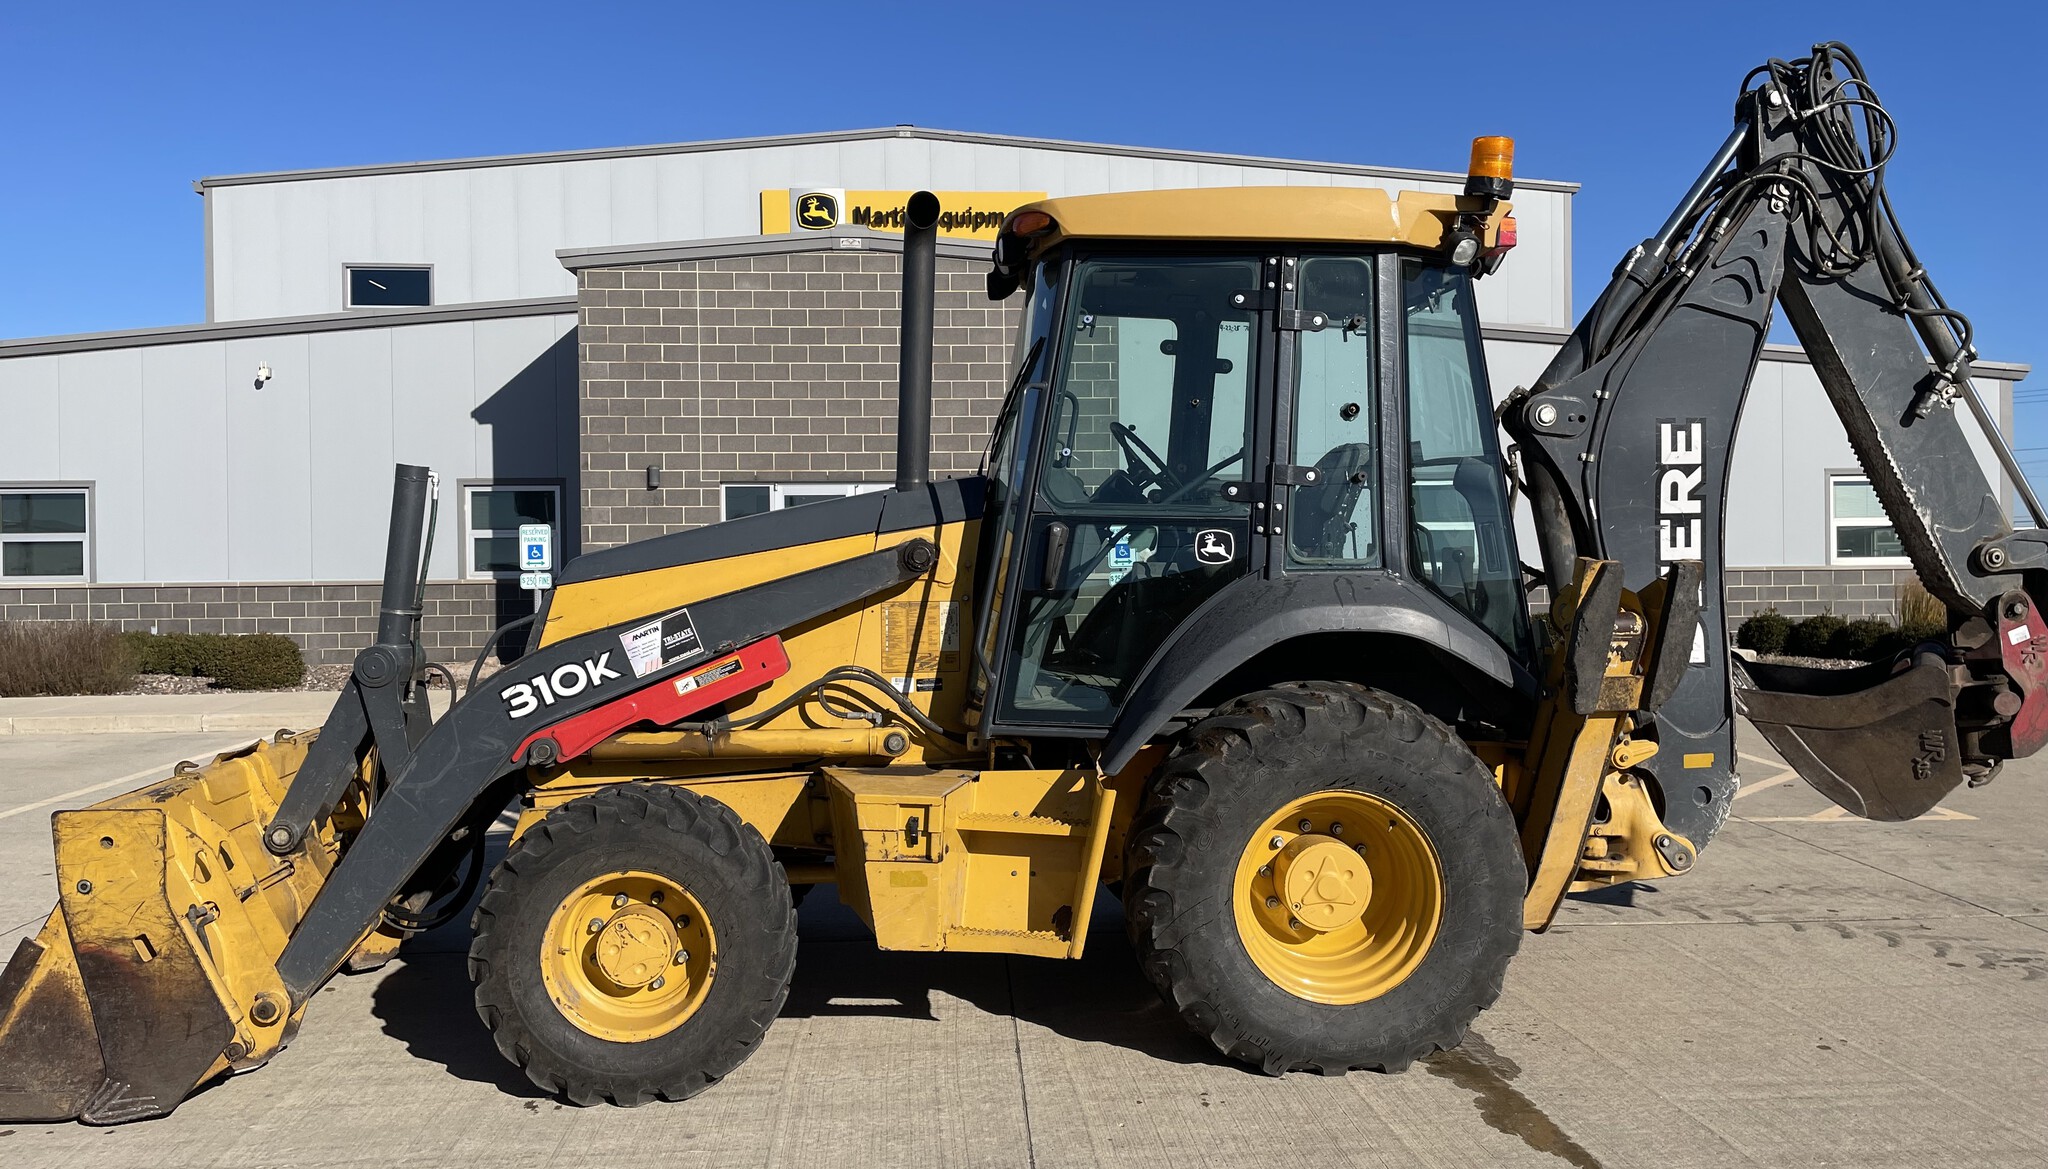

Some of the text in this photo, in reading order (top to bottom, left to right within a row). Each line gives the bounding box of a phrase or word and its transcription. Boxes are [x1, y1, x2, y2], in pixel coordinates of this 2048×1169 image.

[852, 206, 1011, 232] Marti quipm
[1659, 422, 1706, 664] ERE
[538, 576, 550, 585] FINE
[632, 625, 660, 642] MARTIN
[500, 651, 622, 719] 310K
